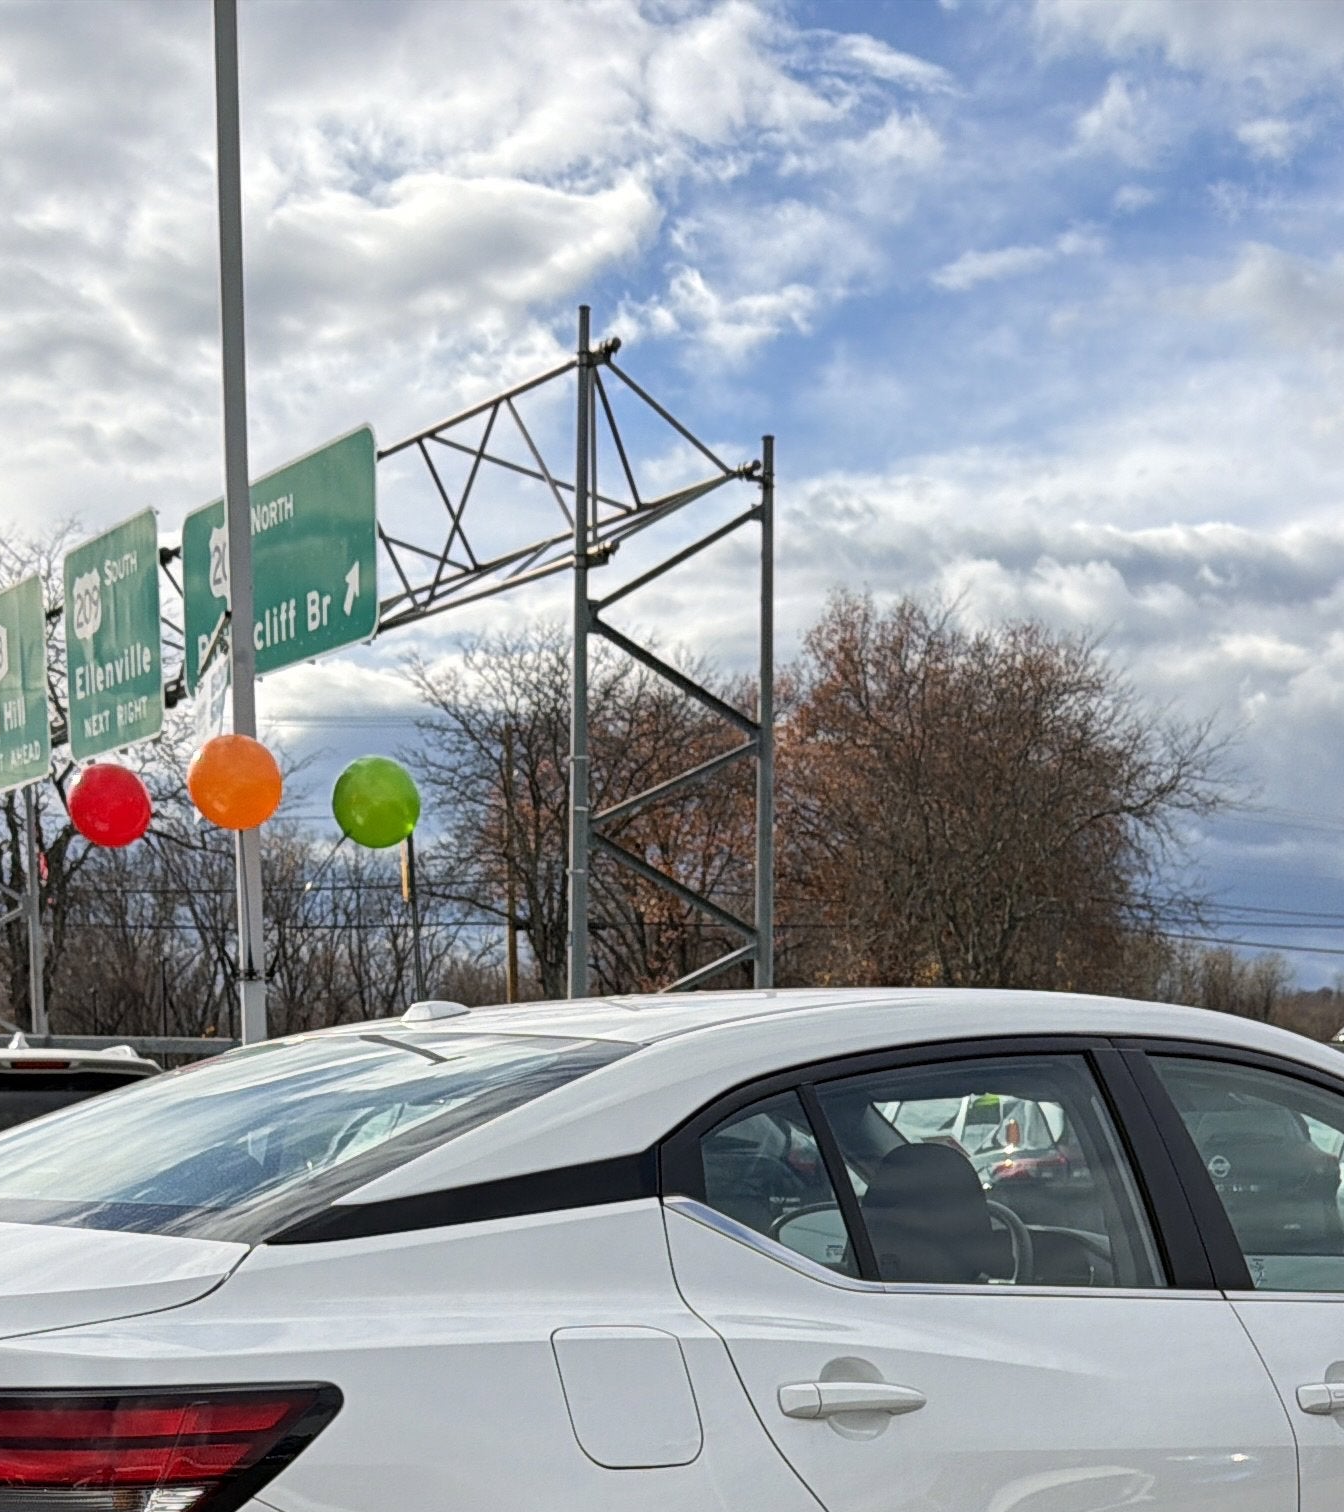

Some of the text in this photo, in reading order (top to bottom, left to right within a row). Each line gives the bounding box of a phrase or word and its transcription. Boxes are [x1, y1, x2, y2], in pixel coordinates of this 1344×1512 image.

[250, 494, 294, 535] NORTH
[104, 551, 138, 586] SOUTH
[76, 584, 100, 630] 209
[306, 590, 331, 632] Br
[75, 642, 152, 701] Ellenville
[3, 696, 26, 732] Hill
[83, 695, 148, 738] NEXT RIGHT
[10, 740, 41, 770] AHEAD
